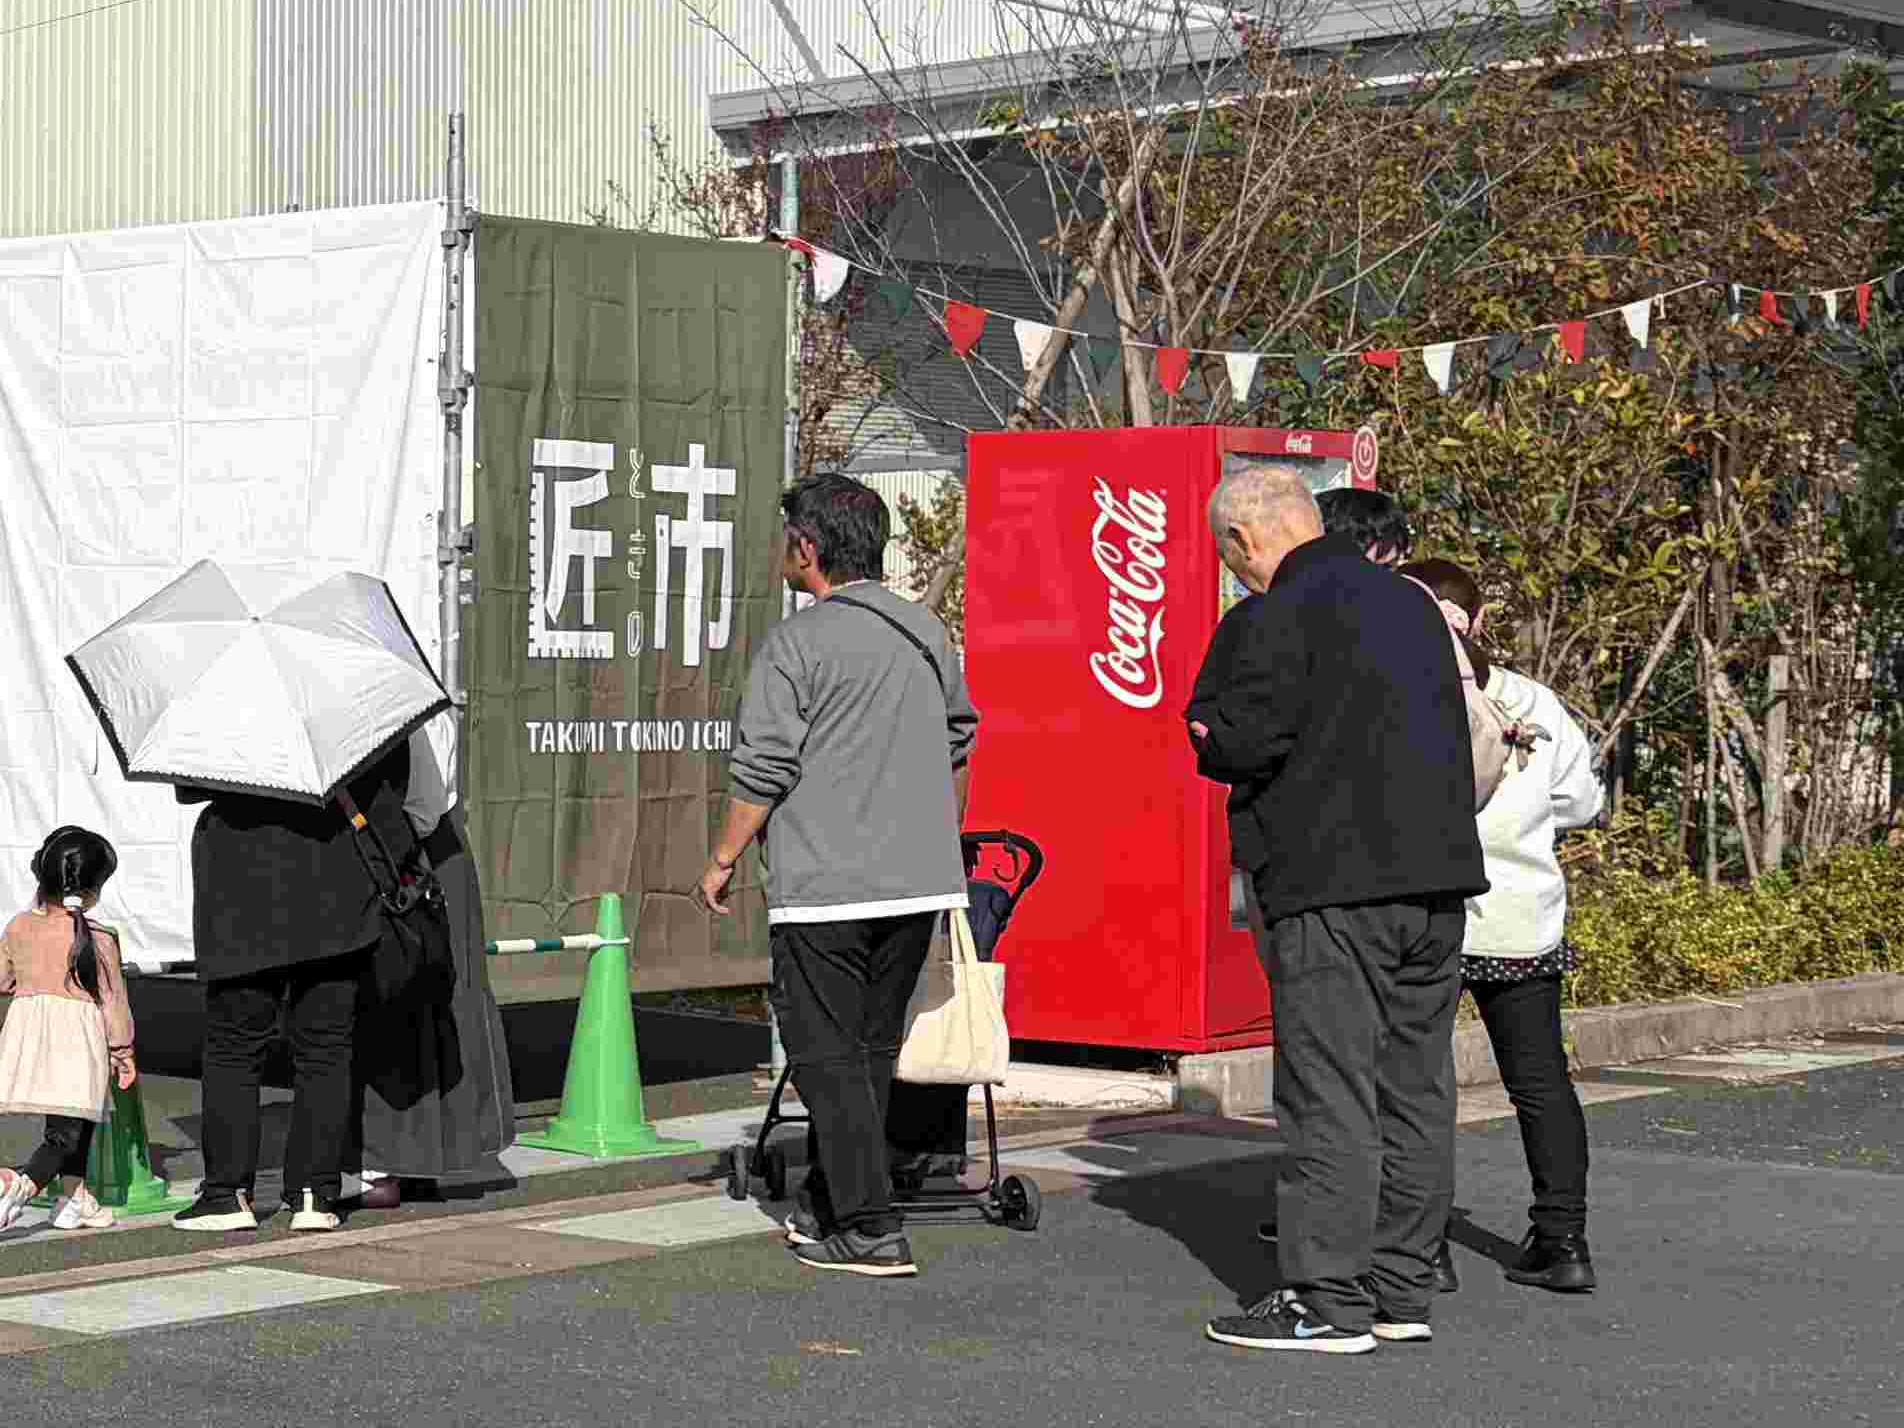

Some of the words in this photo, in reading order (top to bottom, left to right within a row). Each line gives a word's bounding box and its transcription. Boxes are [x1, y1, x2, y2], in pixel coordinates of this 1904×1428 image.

[1089, 475, 1167, 709] Coca-Cola
[525, 721, 605, 754] TAKUMI
[611, 720, 685, 752] TOKINO
[692, 720, 732, 751] ICHI
